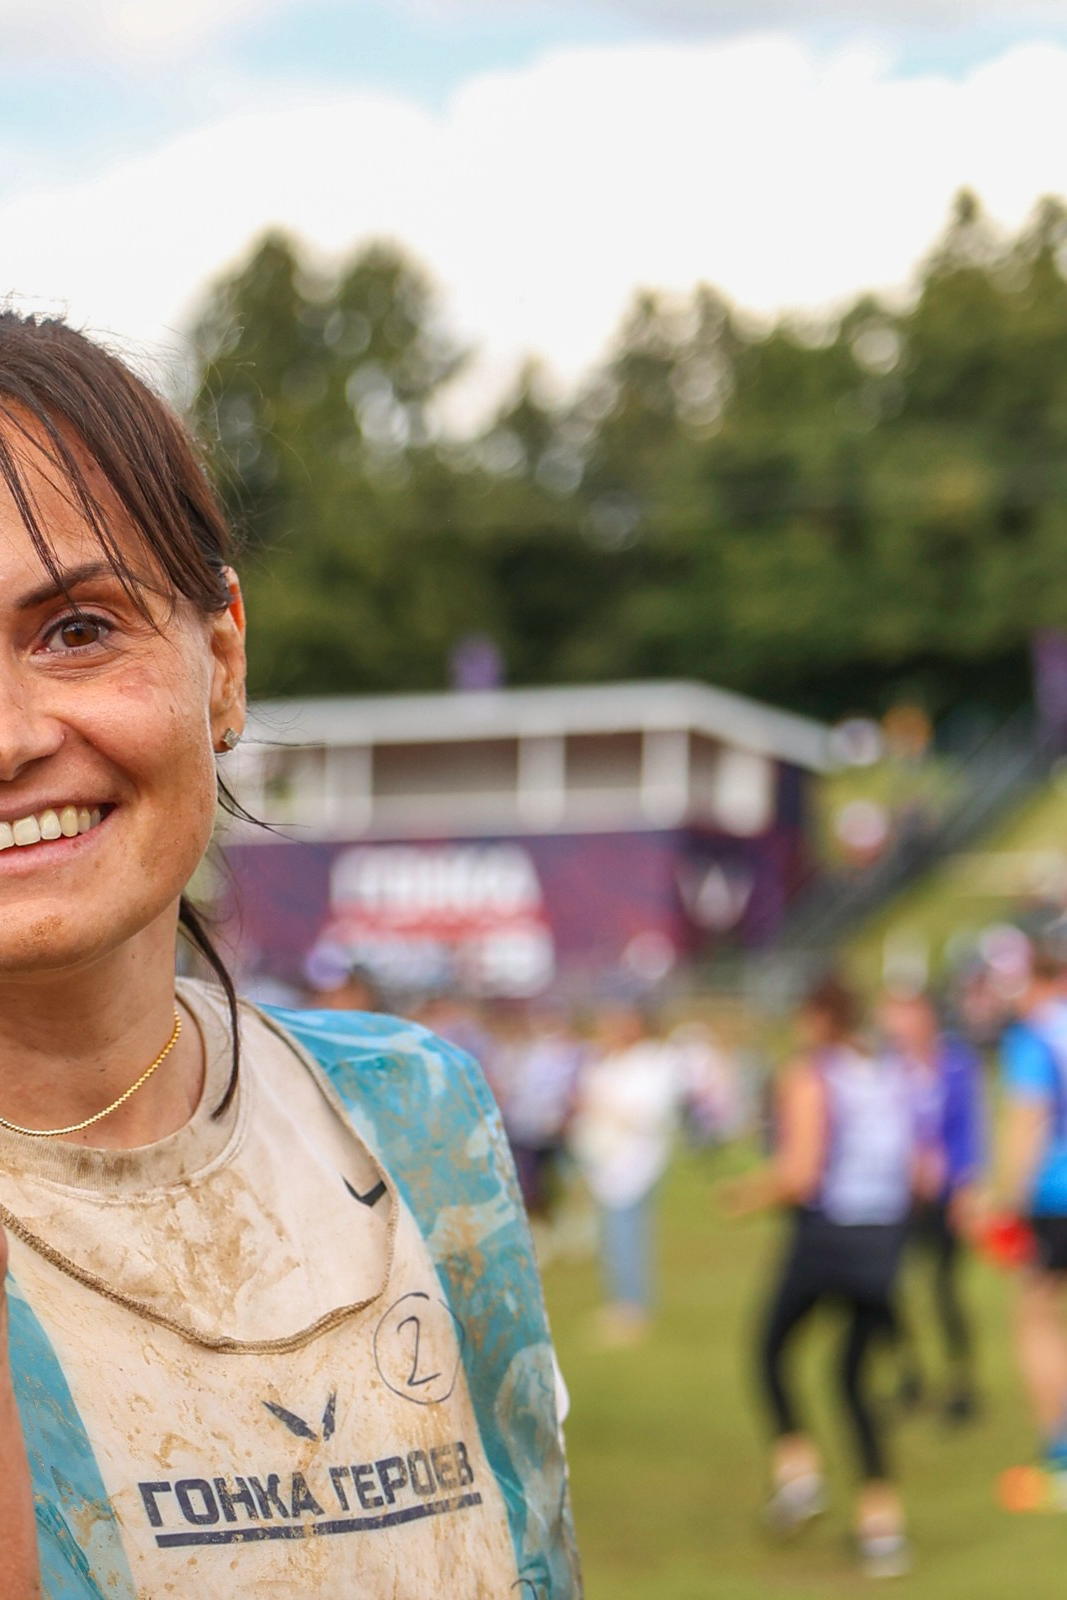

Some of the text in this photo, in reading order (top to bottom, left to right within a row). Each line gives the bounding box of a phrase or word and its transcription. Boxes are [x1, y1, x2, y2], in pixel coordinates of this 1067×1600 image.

[397, 1316, 442, 1387] 2
[137, 1440, 475, 1528] ГОНКА ГЕРОЕВ
